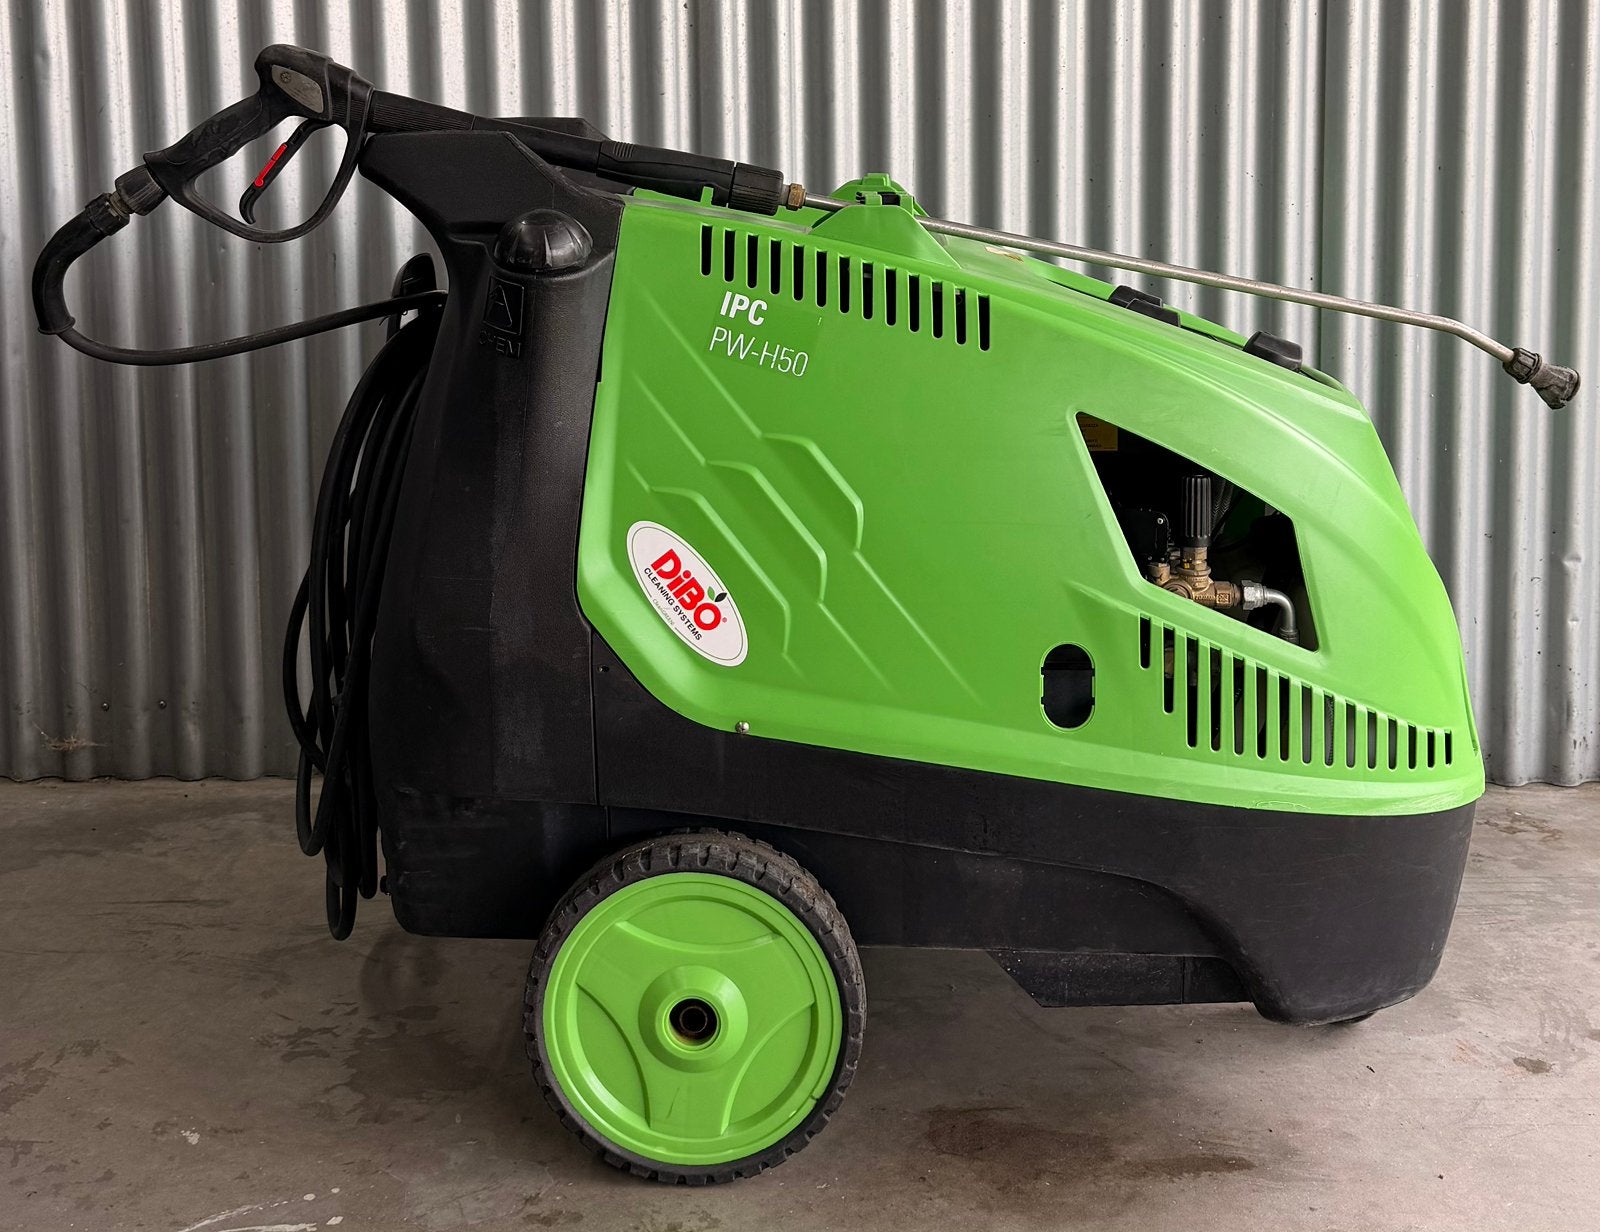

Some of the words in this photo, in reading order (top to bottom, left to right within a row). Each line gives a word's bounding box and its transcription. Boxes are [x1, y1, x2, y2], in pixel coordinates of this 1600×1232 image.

[720, 291, 768, 326] IPC
[709, 326, 809, 377] PW-H50
[644, 567, 675, 606] CLEANING
[673, 605, 703, 641] SYSTEMS
